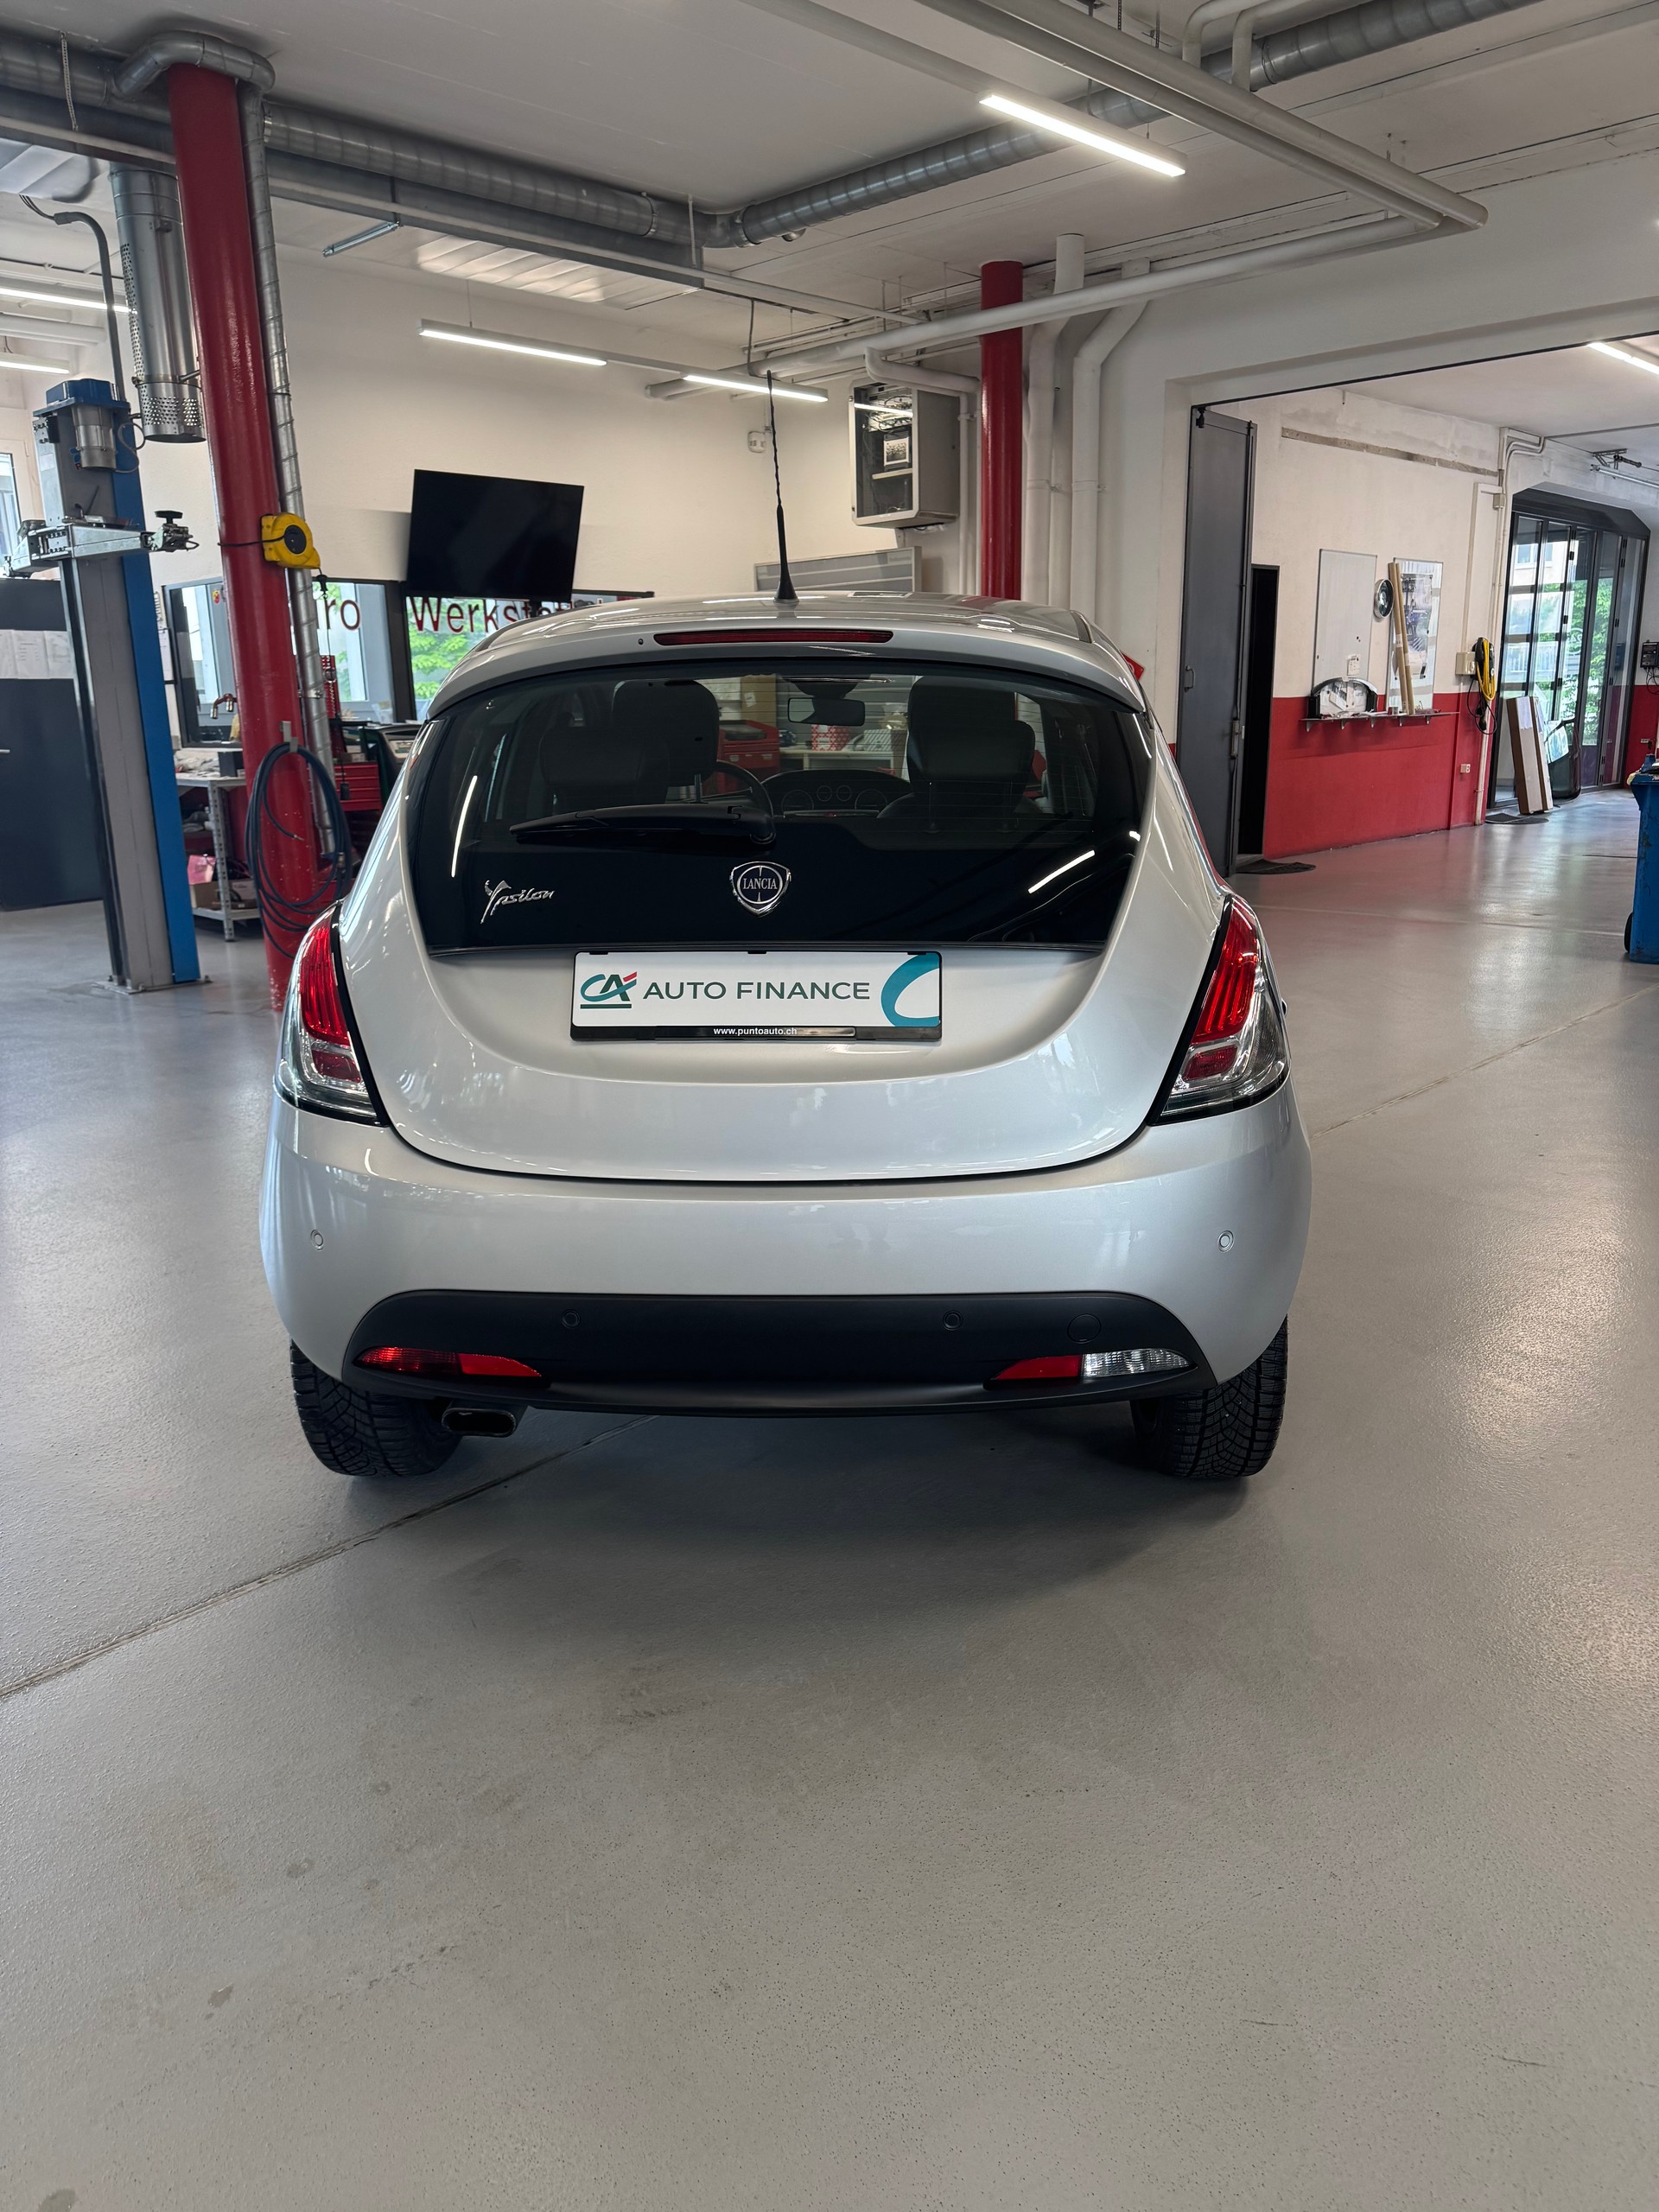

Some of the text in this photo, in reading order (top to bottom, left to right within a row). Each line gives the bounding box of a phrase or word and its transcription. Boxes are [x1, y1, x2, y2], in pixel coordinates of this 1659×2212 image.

[742, 878, 779, 890] LANCIA
[480, 880, 556, 925] Ypsilon
[642, 982, 727, 1001] AUTO
[736, 982, 871, 1001] FINANCE
[713, 1027, 798, 1037] www.puntoauto.ch
